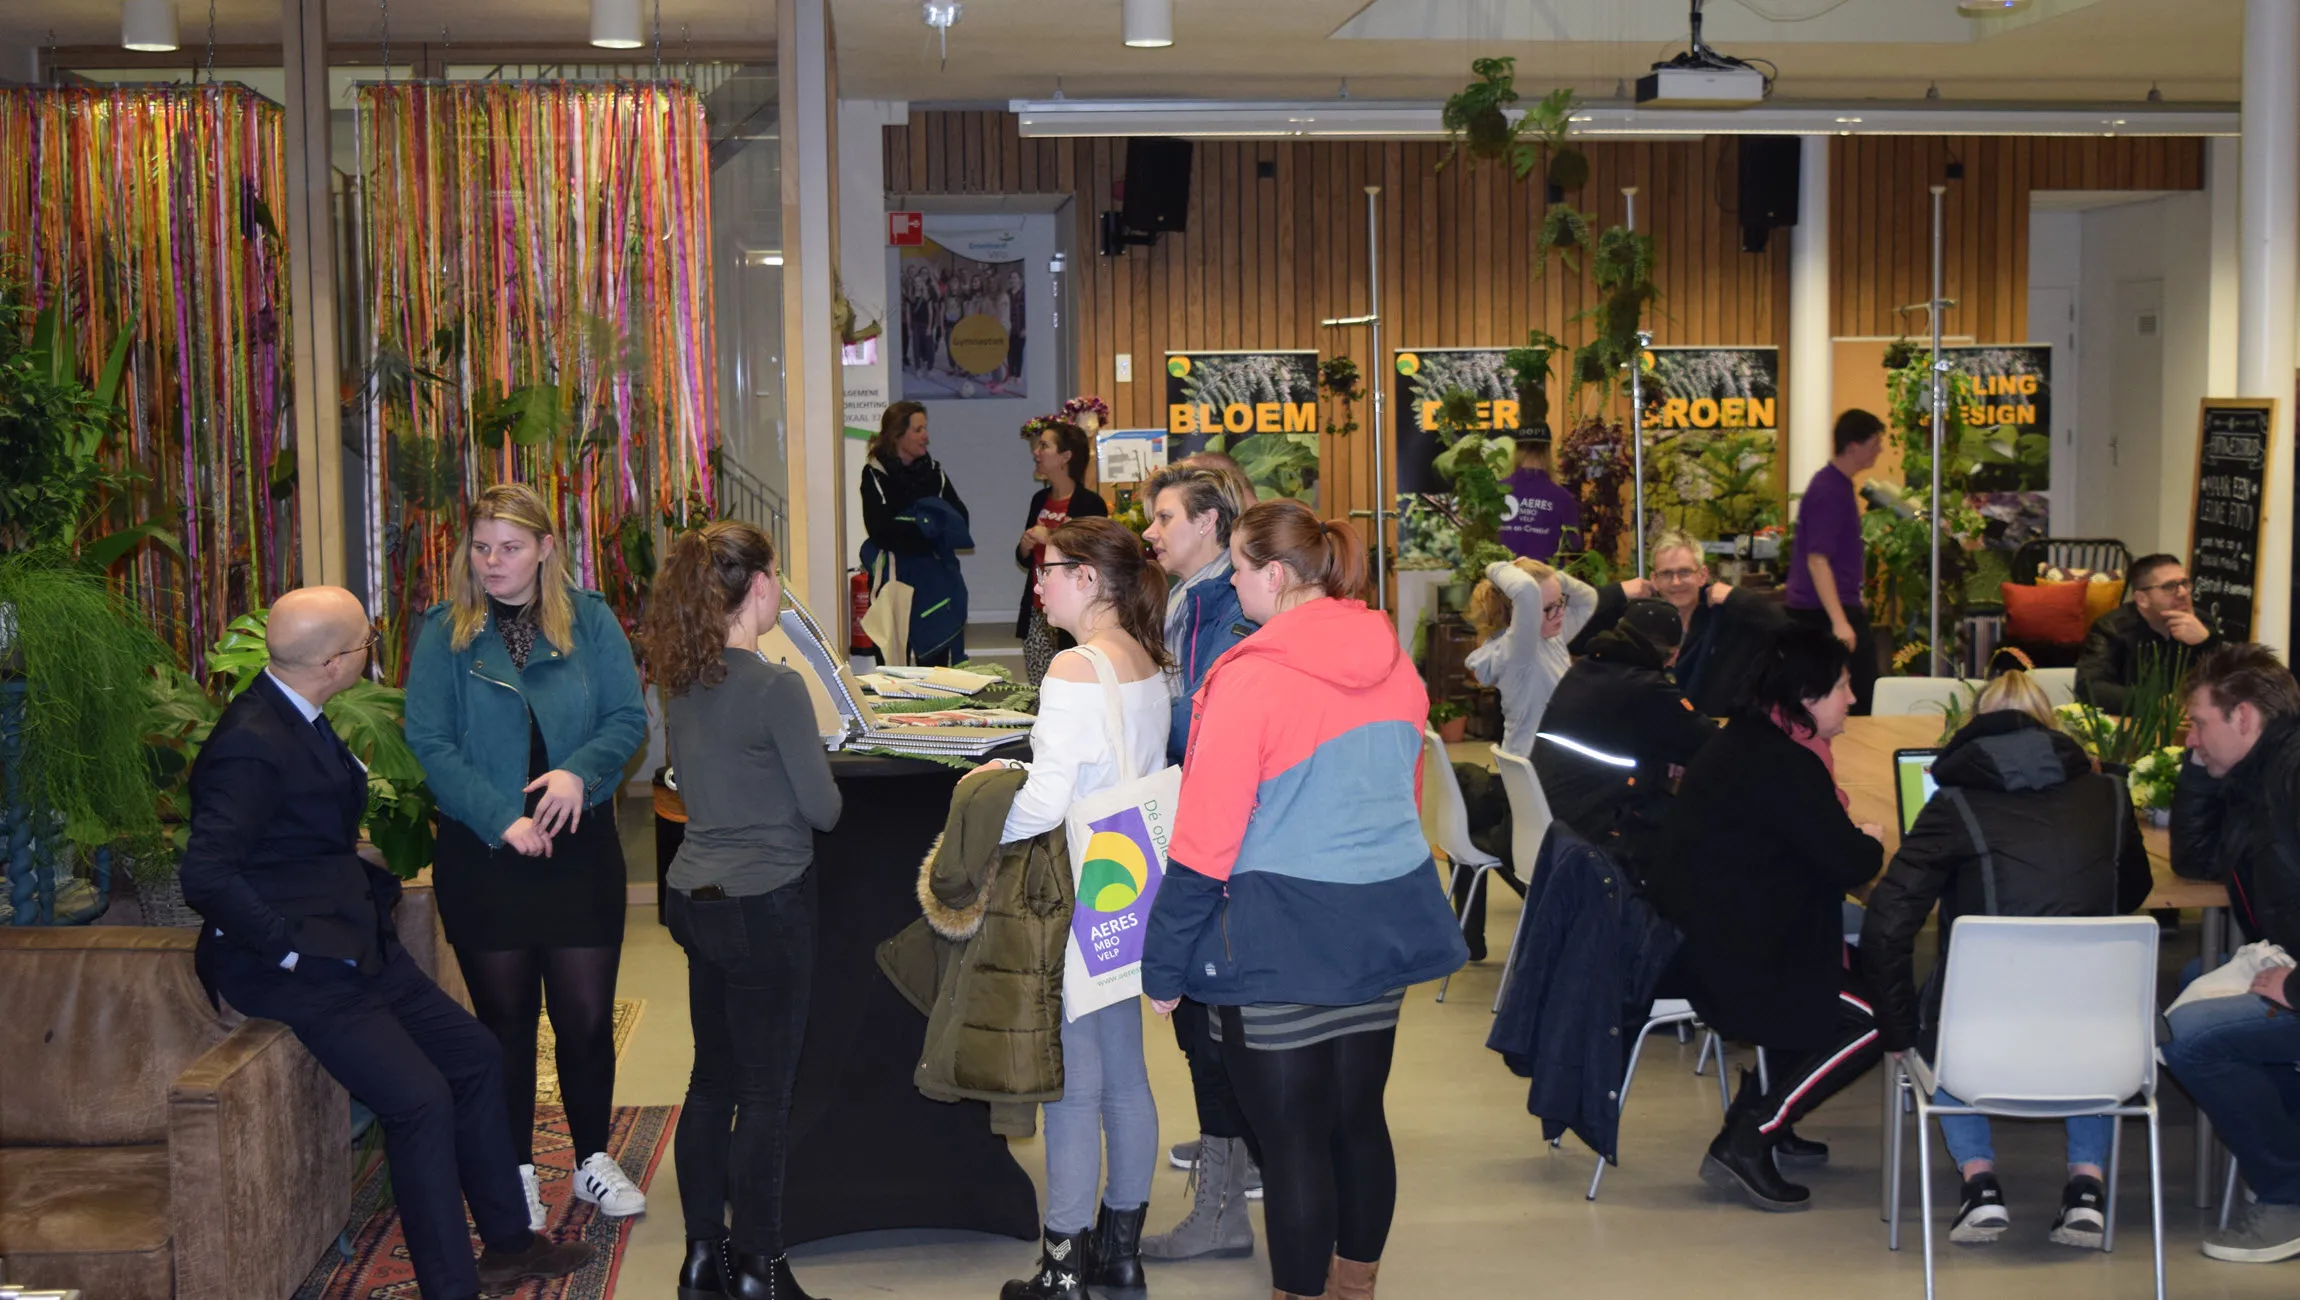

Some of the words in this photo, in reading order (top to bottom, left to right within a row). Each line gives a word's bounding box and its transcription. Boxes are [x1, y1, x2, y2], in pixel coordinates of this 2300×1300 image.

[1959, 374, 2037, 395] LING
[844, 401, 887, 409] ORLICHTING
[1422, 399, 1520, 431] DER
[1944, 404, 2036, 425] ESIGN
[1170, 402, 1316, 433] BLOEM
[1519, 508, 1538, 516] MBO
[1520, 498, 1553, 511] AERES
[1144, 799, 1162, 821] Dé
[1091, 912, 1138, 941] AERES
[1093, 935, 1120, 952] MBO
[1097, 948, 1120, 962] VELP
